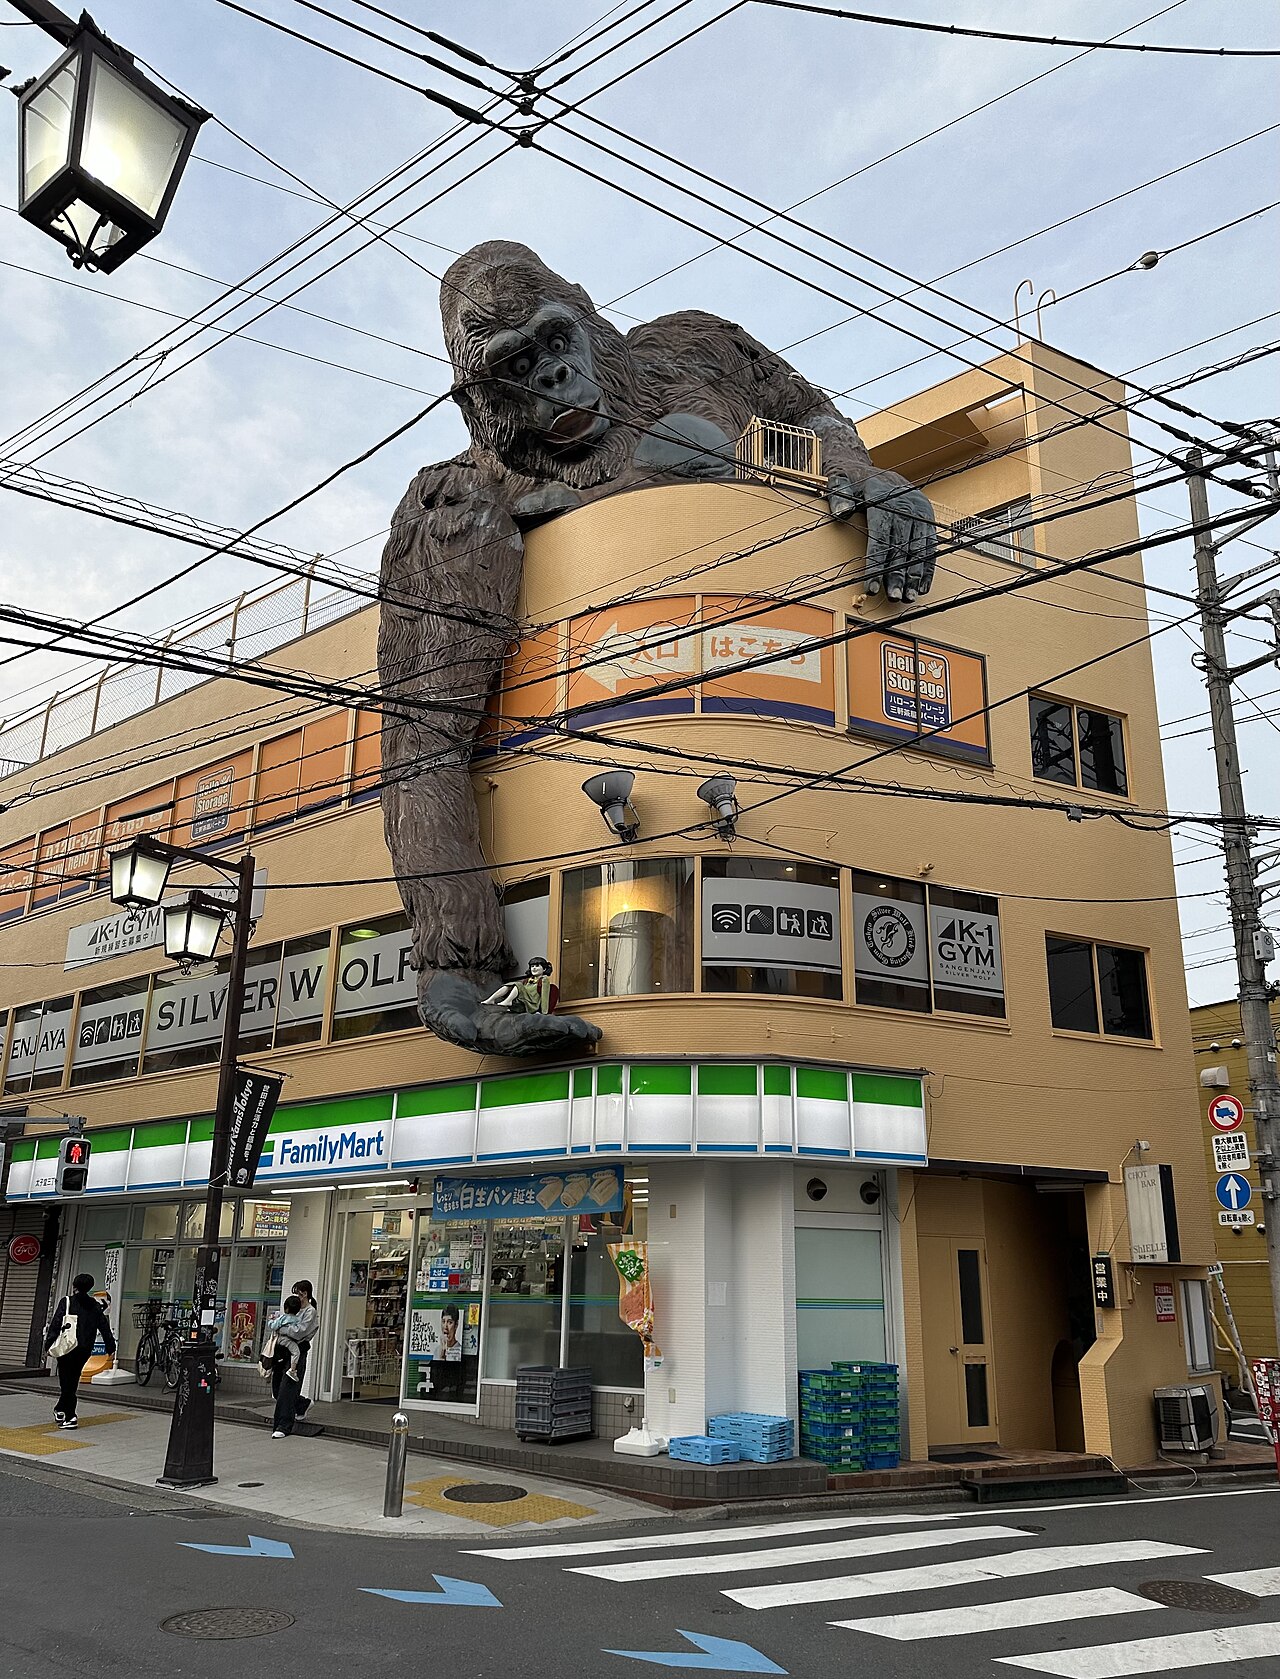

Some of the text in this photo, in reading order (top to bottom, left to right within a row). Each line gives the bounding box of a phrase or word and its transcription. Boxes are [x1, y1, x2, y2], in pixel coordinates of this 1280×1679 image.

[887, 651, 927, 675] Hello
[888, 671, 945, 699] Storage
[196, 792, 228, 814] Storage
[98, 907, 161, 943] K-1 GYM
[958, 919, 994, 947] K-1
[938, 941, 995, 968] GYM
[940, 962, 997, 977] SANGENJAYA
[945, 970, 969, 978] SILVER
[156, 977, 277, 1031] SILVER
[233, 1079, 253, 1114] Tokyo
[280, 1130, 384, 1165] FamilyMart
[1127, 1171, 1148, 1180] CHOT
[1141, 1179, 1156, 1188] BAR
[1221, 1213, 1252, 1223] 自転車を除く
[1095, 1262, 1108, 1302] 営業中
